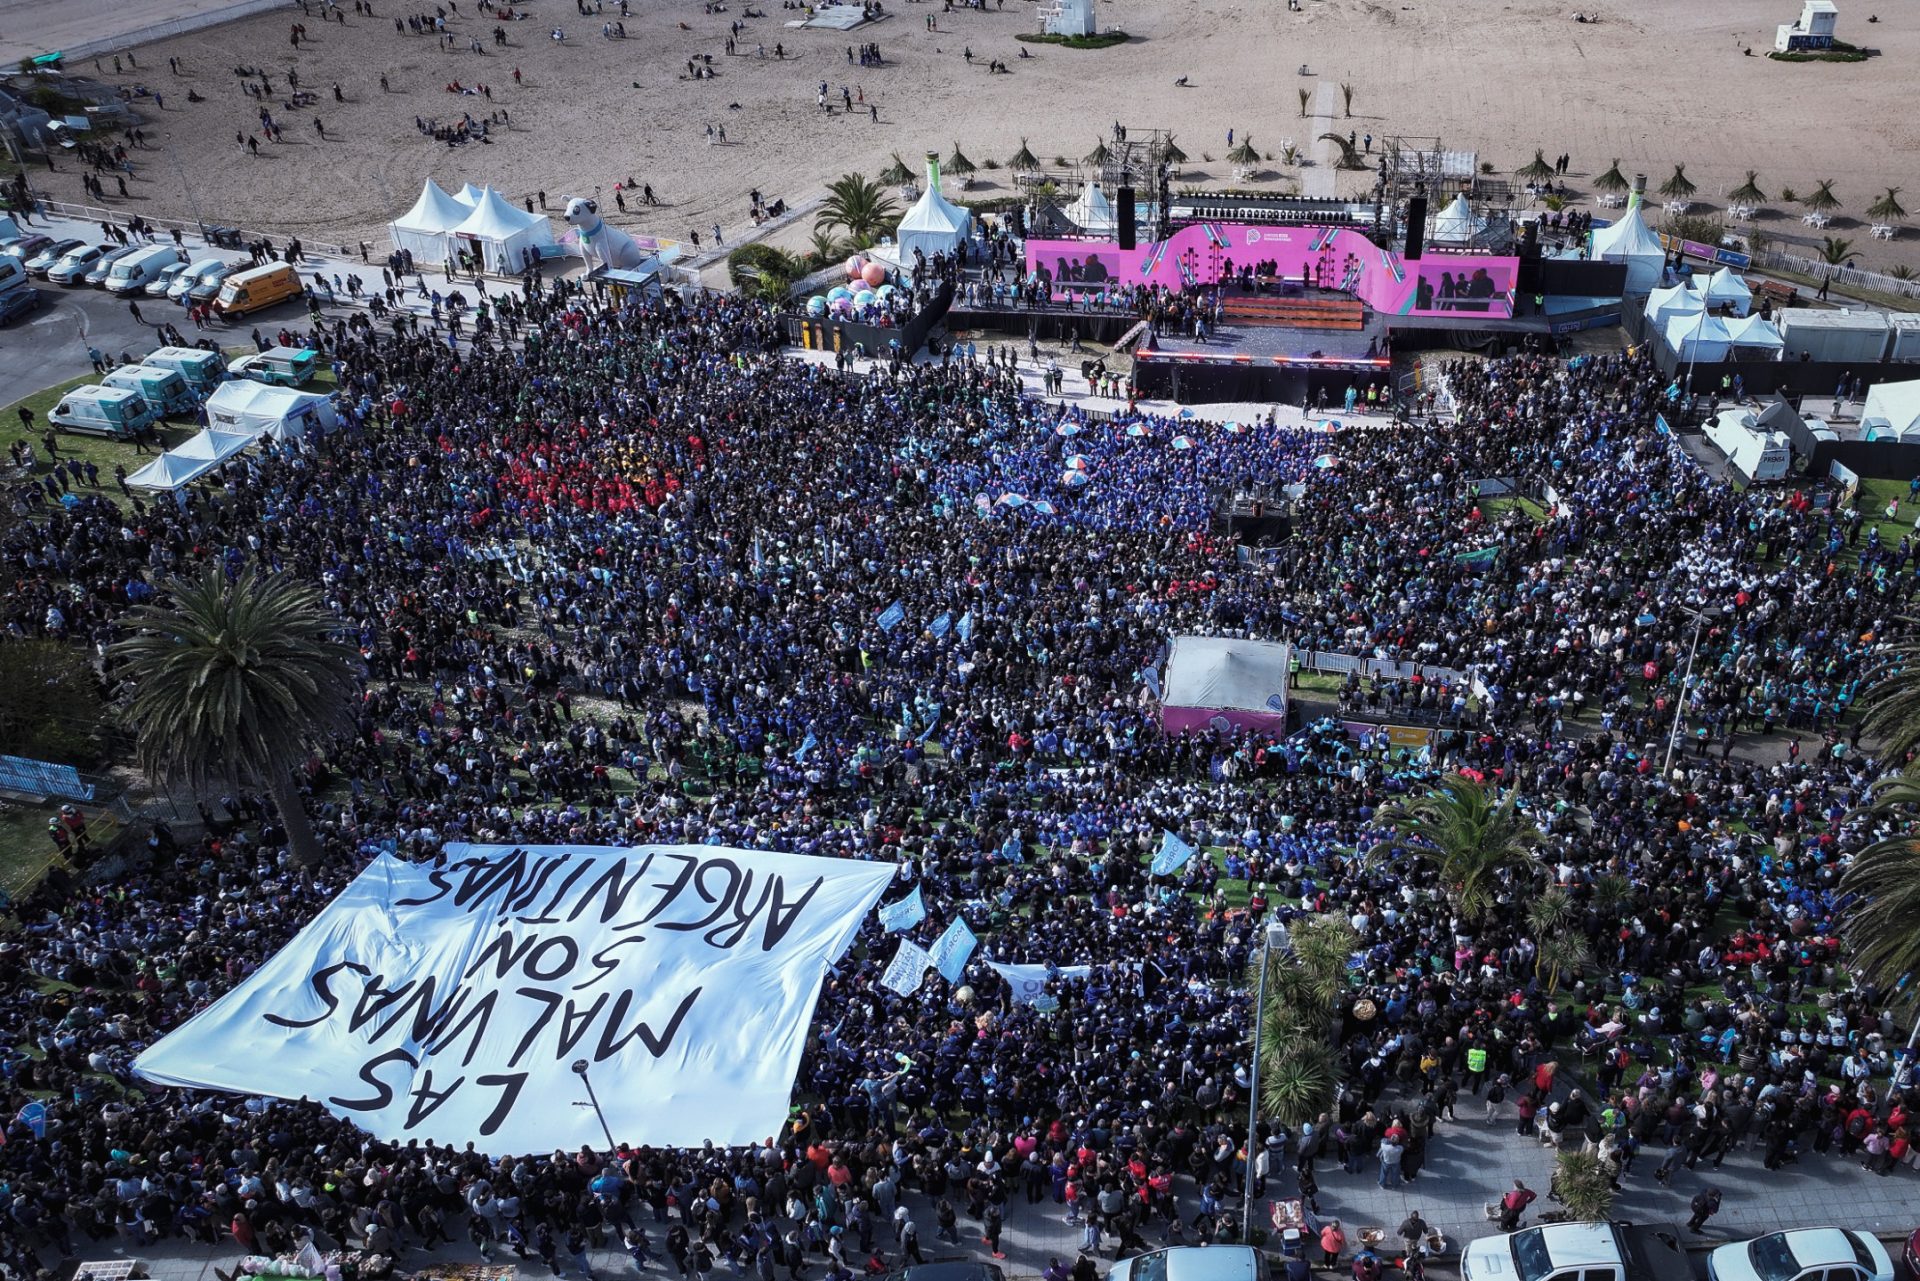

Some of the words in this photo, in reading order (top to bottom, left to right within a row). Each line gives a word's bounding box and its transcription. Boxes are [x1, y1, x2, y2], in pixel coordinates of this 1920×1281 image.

[1763, 456, 1785, 464] PRENSA
[466, 930, 646, 991] SON
[263, 961, 703, 1067] MALVINAS
[329, 1048, 529, 1136] LAS
